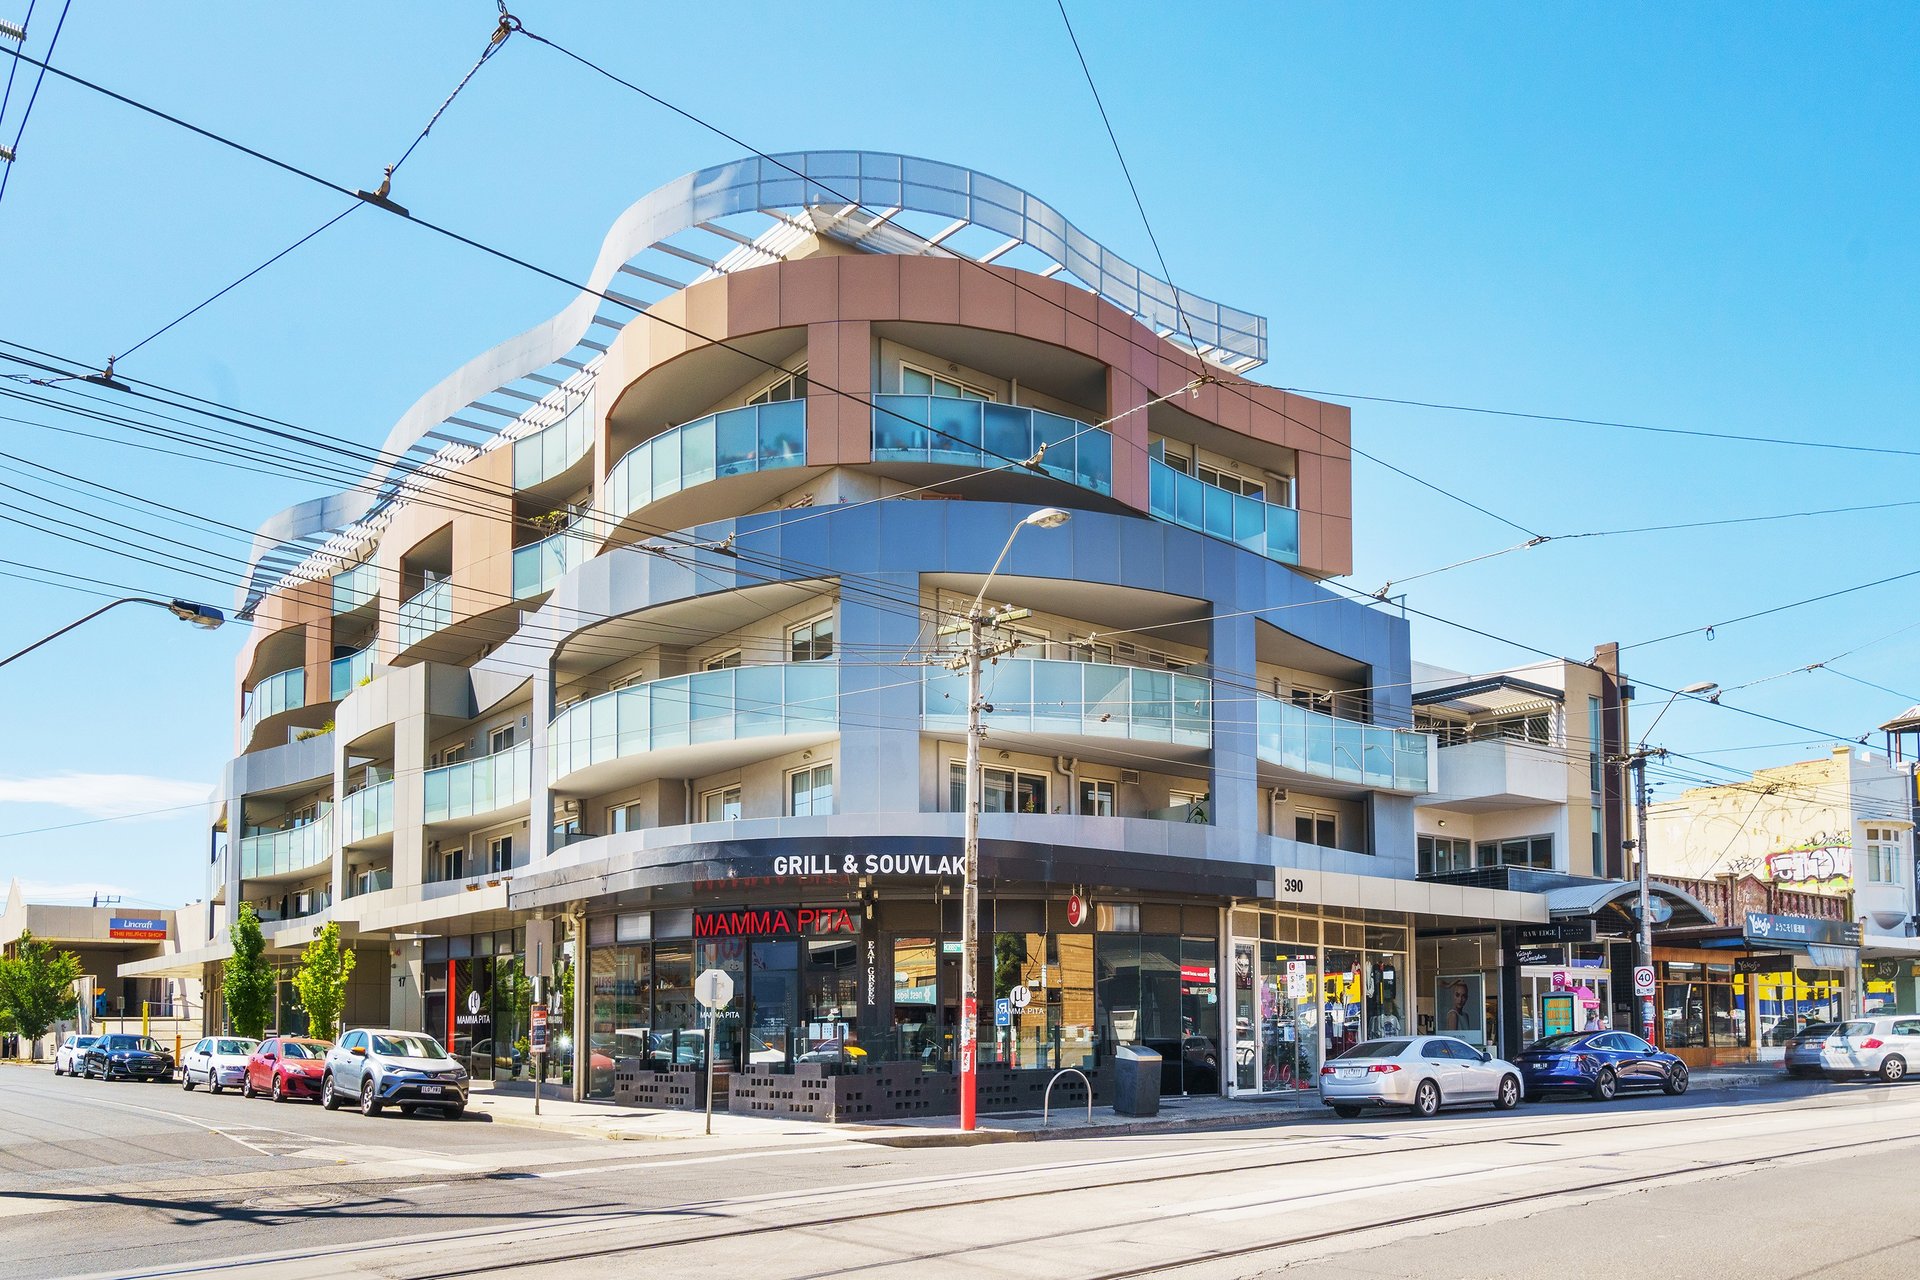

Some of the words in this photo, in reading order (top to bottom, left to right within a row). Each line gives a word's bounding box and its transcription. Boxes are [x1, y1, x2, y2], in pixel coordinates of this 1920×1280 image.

[773, 855, 837, 876] GRILL
[843, 854, 859, 875] &
[864, 854, 966, 875] SOUVLAK
[1284, 878, 1304, 893] 390
[123, 920, 152, 929] Lincraft
[694, 910, 791, 937] MAMMA
[797, 908, 855, 933] PITA
[1538, 929, 1557, 937] EDGE
[867, 940, 875, 964] EAT
[398, 976, 406, 987] 17
[1638, 973, 1651, 982] 40
[867, 966, 875, 1006] GREEK
[456, 1015, 479, 1024] MAMMA
[479, 1015, 491, 1024] PITA
[725, 1011, 740, 1019] PITA
